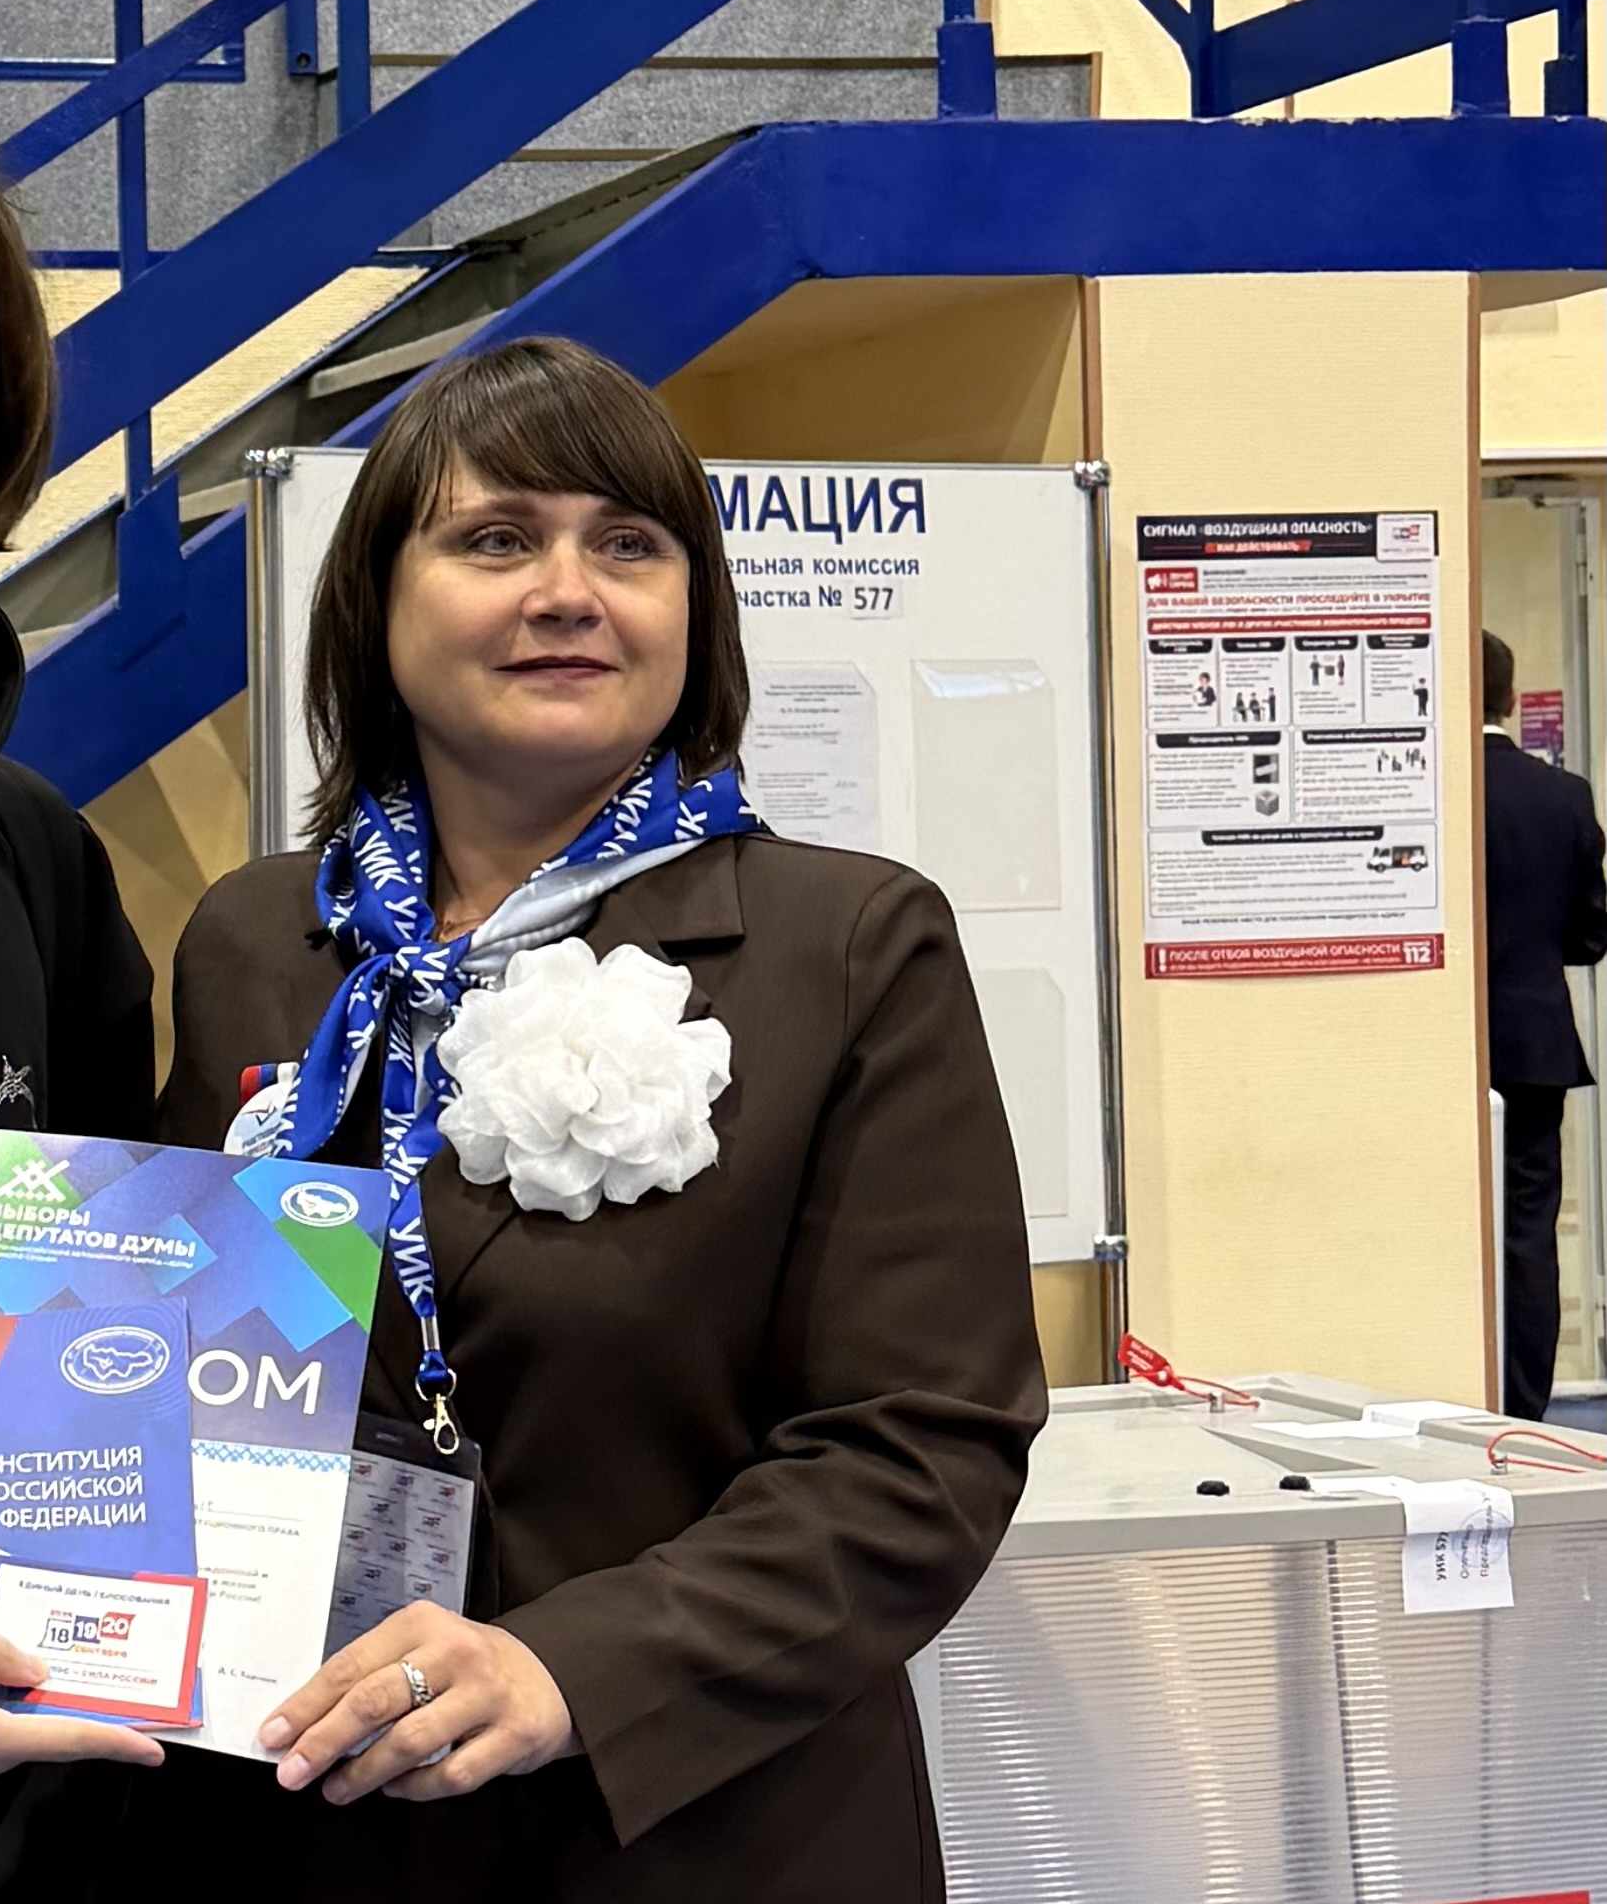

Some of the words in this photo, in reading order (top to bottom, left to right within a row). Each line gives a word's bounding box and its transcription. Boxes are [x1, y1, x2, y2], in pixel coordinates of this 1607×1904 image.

[708, 474, 927, 544] МАЦИЯ
[726, 558, 803, 575] ельная
[813, 558, 920, 576] комиссия
[736, 589, 811, 608] частка
[818, 586, 843, 608] №
[854, 587, 893, 611] 577
[355, 830, 410, 891] УИК
[1169, 950, 1208, 962] ПОСЛЕ
[1403, 946, 1431, 964] 112
[119, 1235, 196, 1258] ДУМЫ
[390, 1216, 434, 1305] УИК
[187, 1349, 322, 1415] ОМ
[0, 1502, 146, 1531] ФЕДЕРАЦИИ
[1436, 1554, 1447, 1581] УИК
[50, 1627, 69, 1643] 18
[75, 1621, 97, 1639] 19
[102, 1617, 129, 1635] 20
